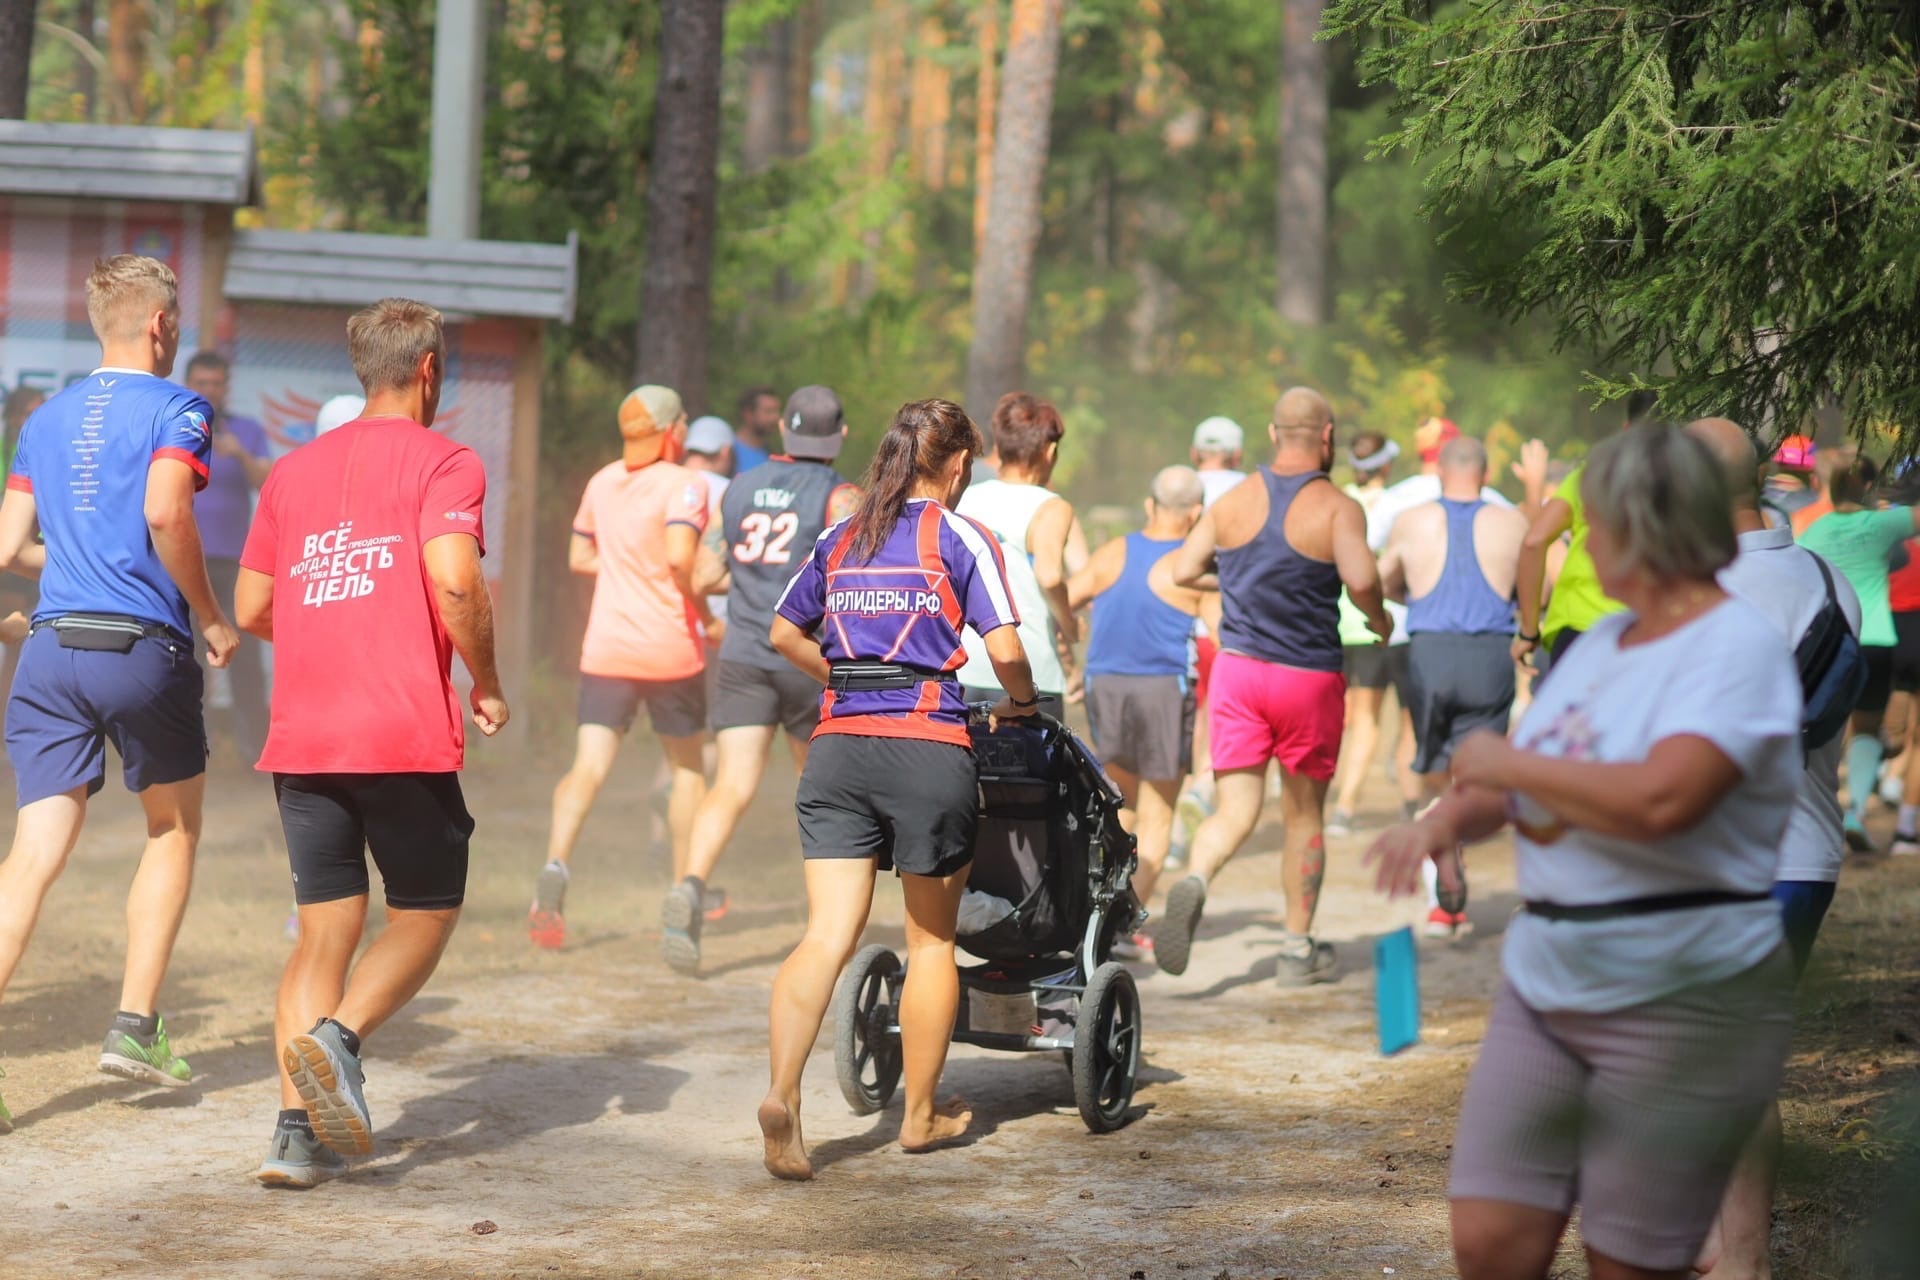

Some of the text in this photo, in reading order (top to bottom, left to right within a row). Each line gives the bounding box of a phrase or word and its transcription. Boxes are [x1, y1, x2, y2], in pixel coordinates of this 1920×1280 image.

[303, 521, 353, 559] ВСЁ
[734, 512, 799, 564] 32
[290, 555, 330, 578] КОГДА
[309, 570, 328, 580] ТЕБЯ
[330, 545, 394, 577] ЕСТЬ
[303, 573, 375, 608] ЦЕЛЬ
